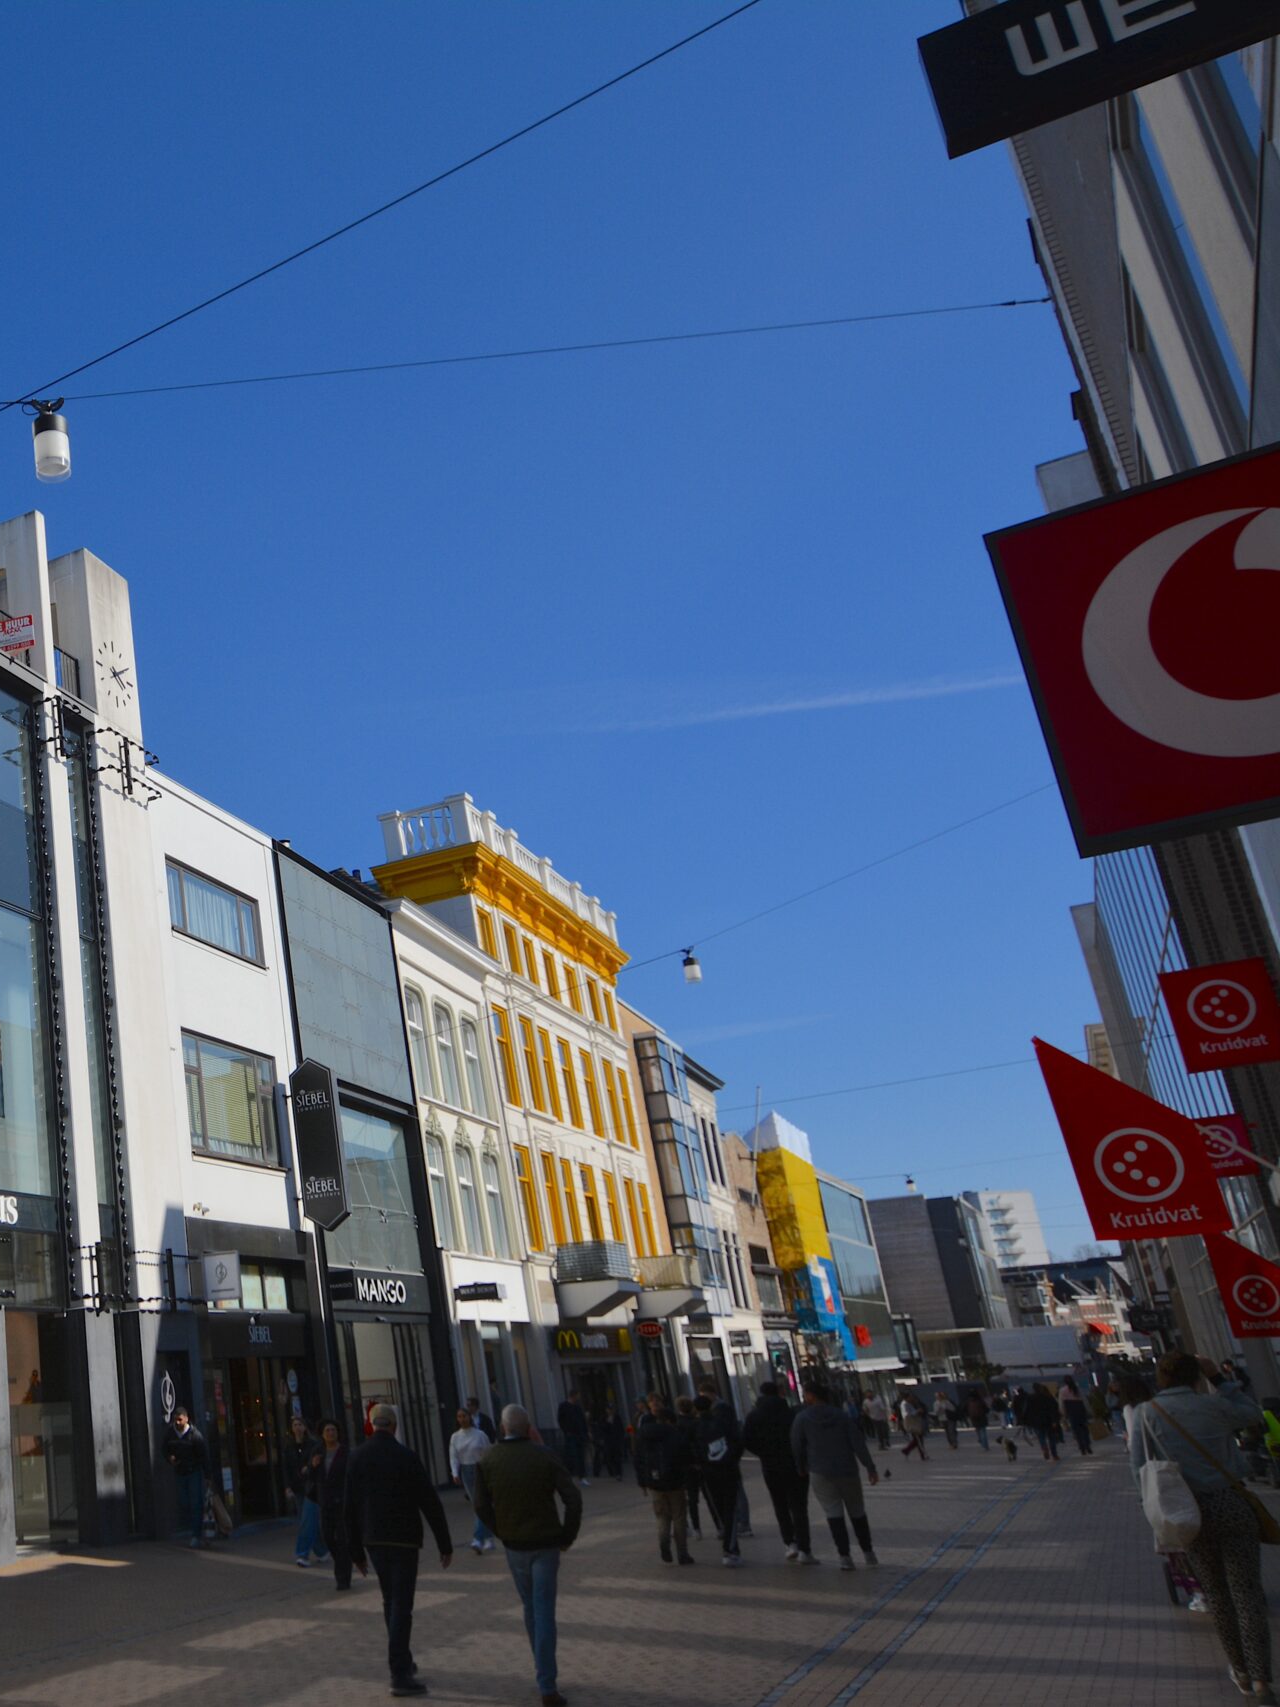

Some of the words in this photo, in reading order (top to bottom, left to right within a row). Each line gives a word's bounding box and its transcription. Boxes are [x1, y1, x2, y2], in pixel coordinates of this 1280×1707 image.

[5, 617, 30, 629] HUUR
[1199, 1034, 1269, 1054] Kruidvat
[296, 1092, 329, 1107] SIEBEL
[305, 1179, 340, 1194] SIEBEL
[1109, 1204, 1204, 1229] Kruidvat
[357, 1277, 407, 1304] MANGO
[248, 1325, 272, 1343] SIEBEL
